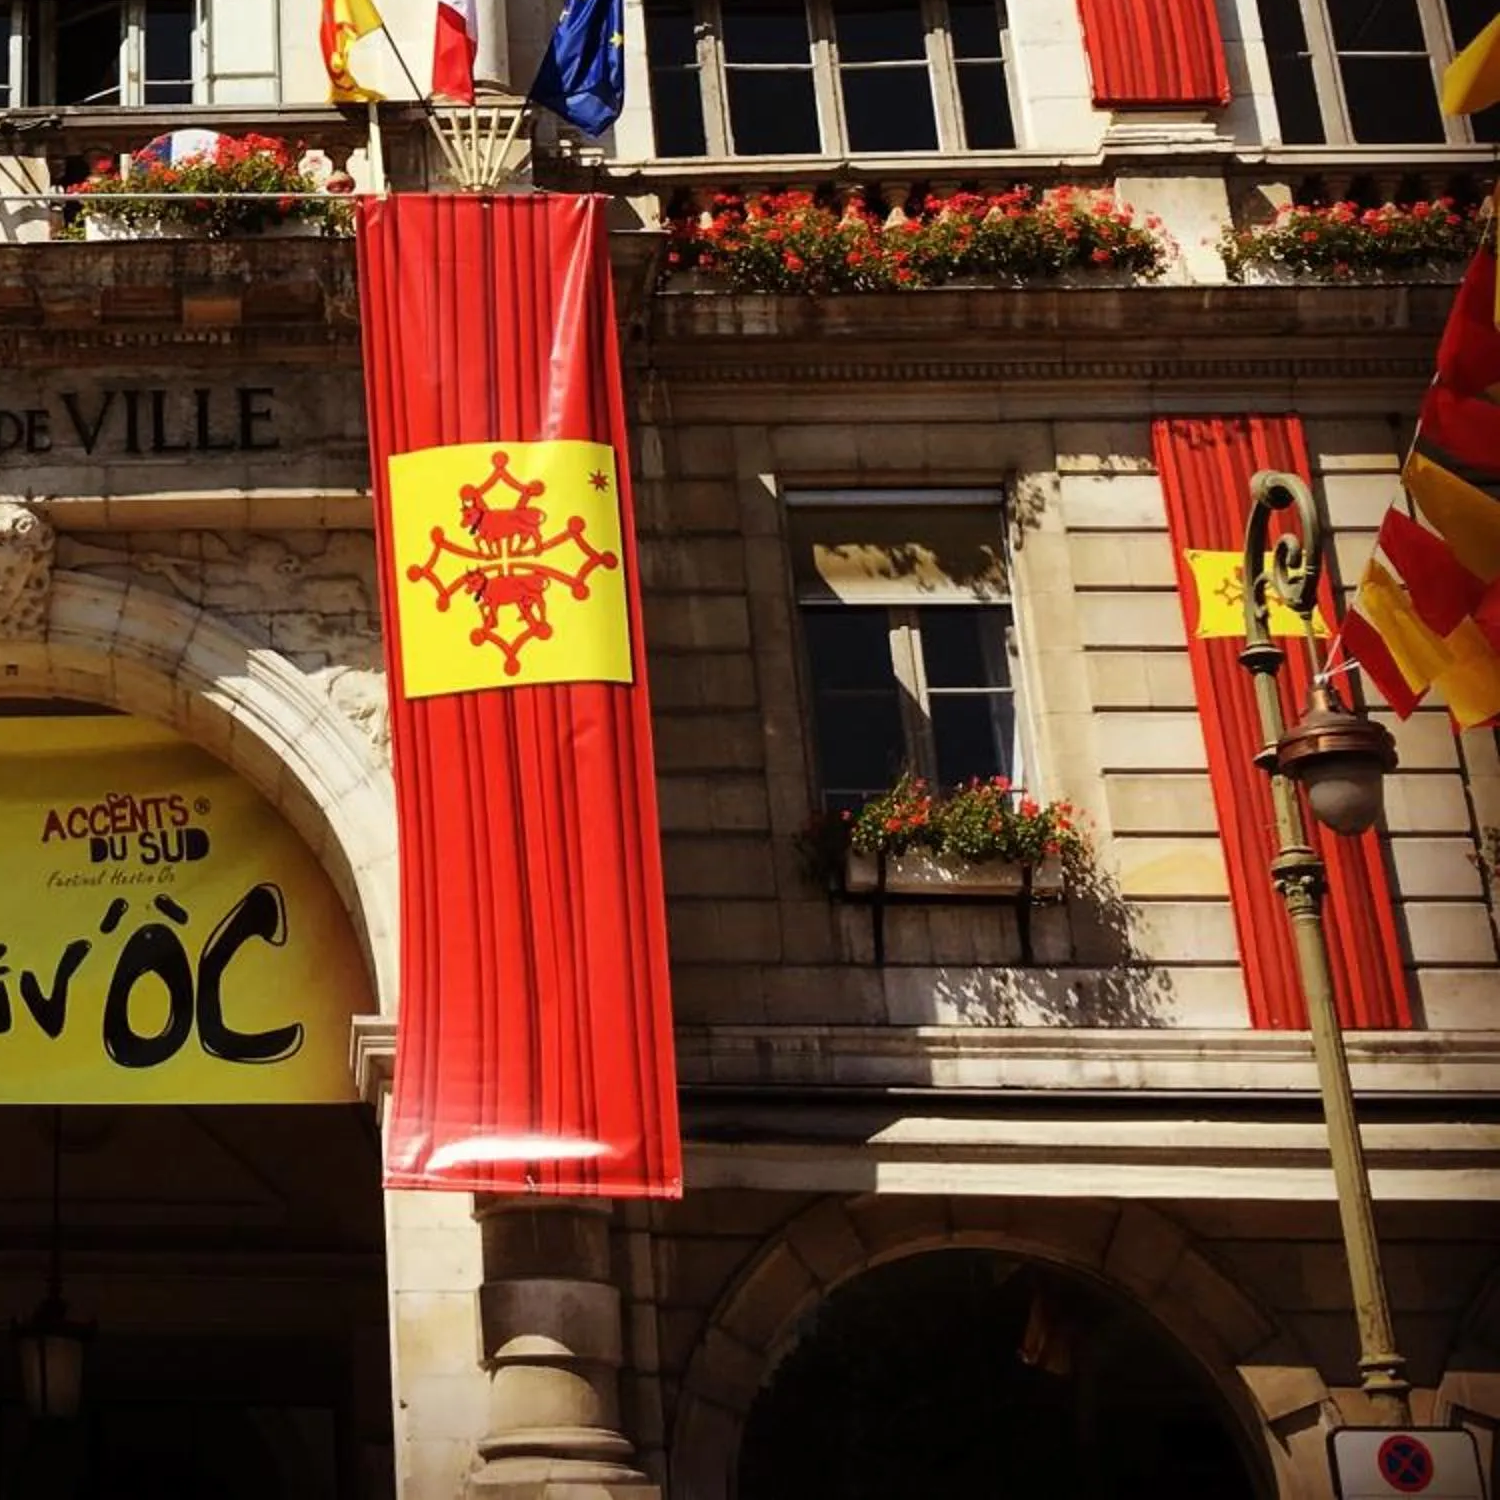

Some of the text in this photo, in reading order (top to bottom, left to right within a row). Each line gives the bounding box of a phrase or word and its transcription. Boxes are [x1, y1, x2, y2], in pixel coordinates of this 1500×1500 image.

[63, 387, 280, 456] VILLE
[90, 827, 210, 864] DU SUD
